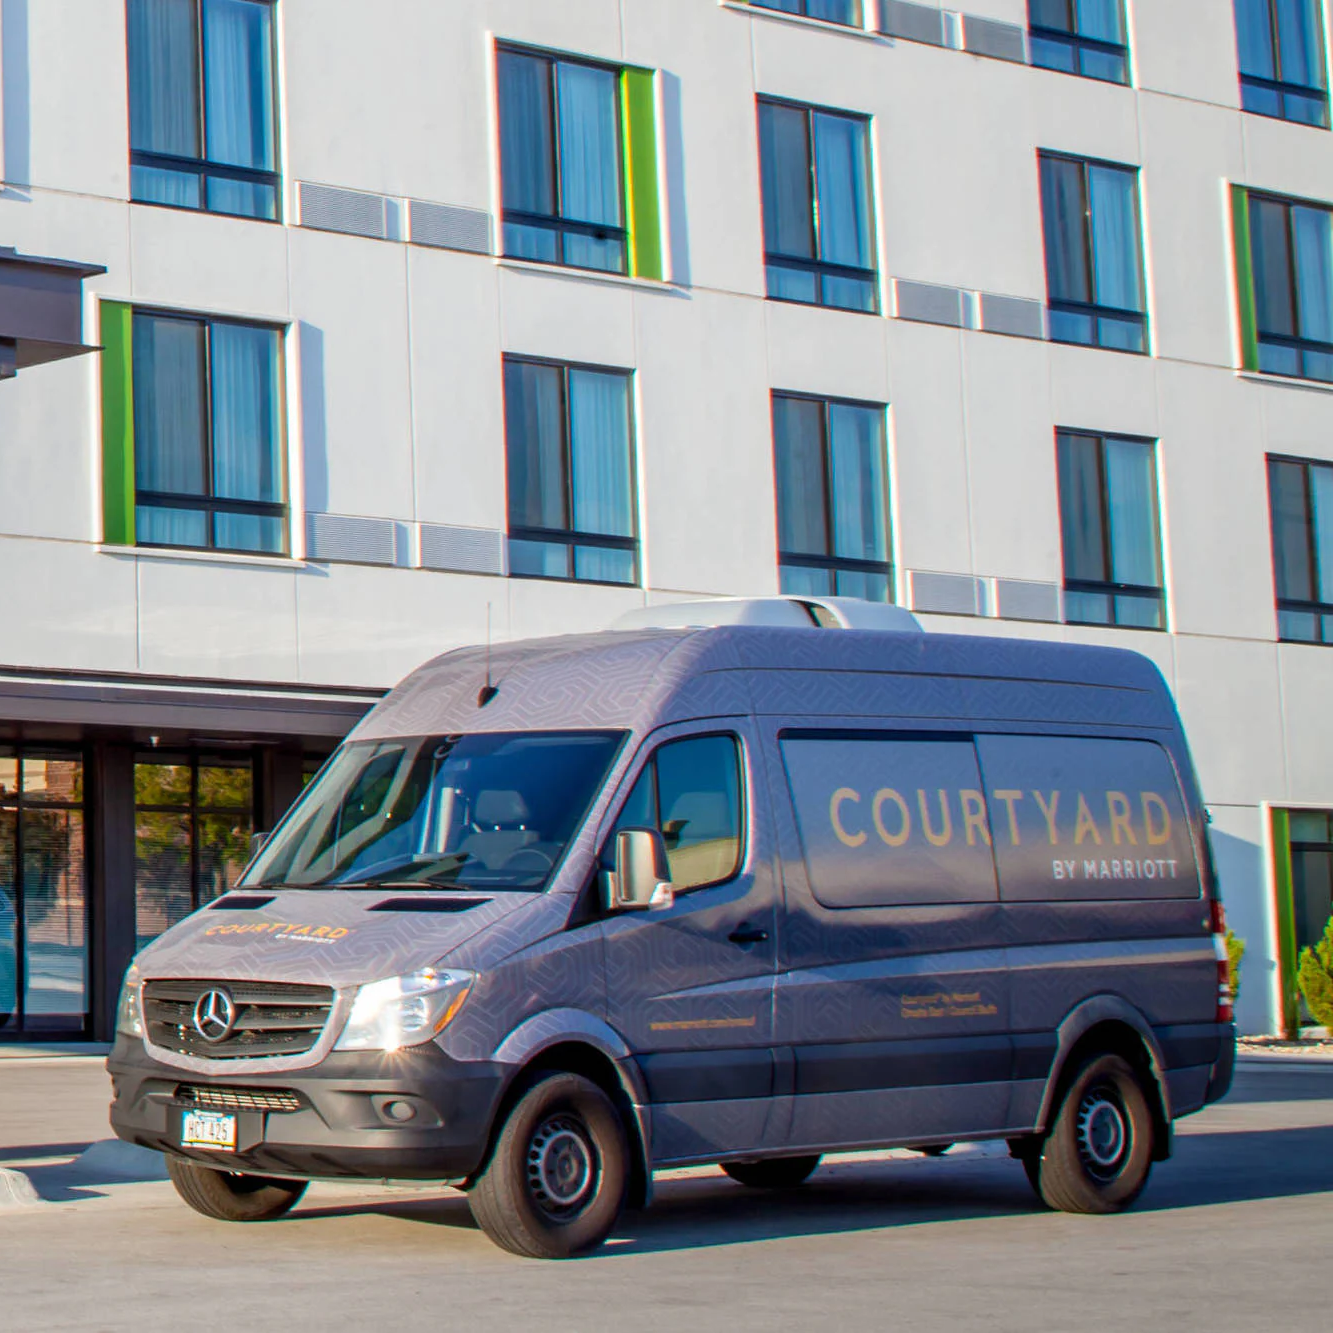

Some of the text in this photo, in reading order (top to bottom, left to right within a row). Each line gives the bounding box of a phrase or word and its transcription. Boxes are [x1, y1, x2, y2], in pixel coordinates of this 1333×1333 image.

[829, 787, 1173, 848] COURTYARD
[1052, 860, 1178, 880] BY MARRIOTT
